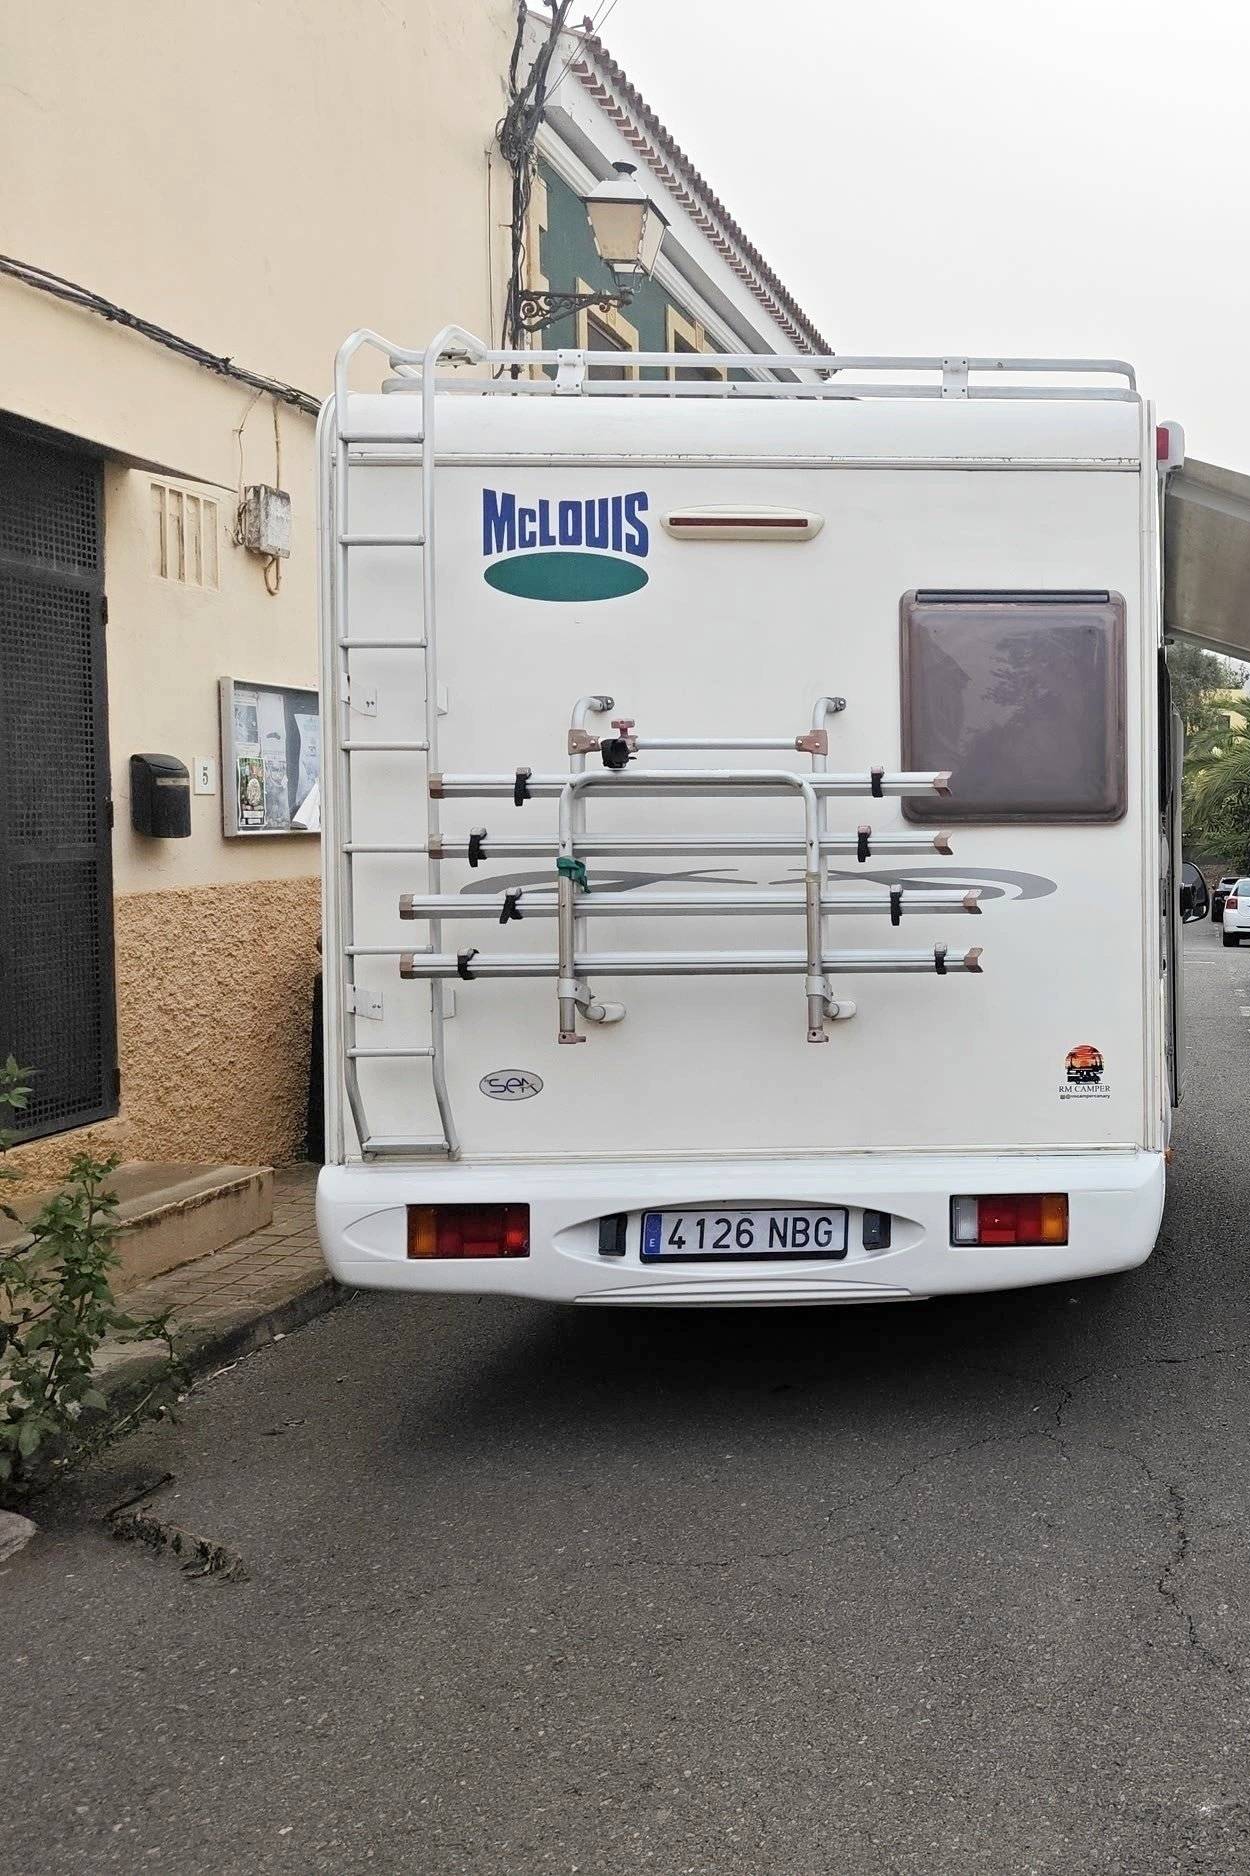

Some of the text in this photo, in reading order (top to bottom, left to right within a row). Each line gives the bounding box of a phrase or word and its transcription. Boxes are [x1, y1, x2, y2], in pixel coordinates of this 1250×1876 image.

[1058, 1085, 1111, 1093] RM CAMPER
[649, 1216, 834, 1250] E 4126 NBG
